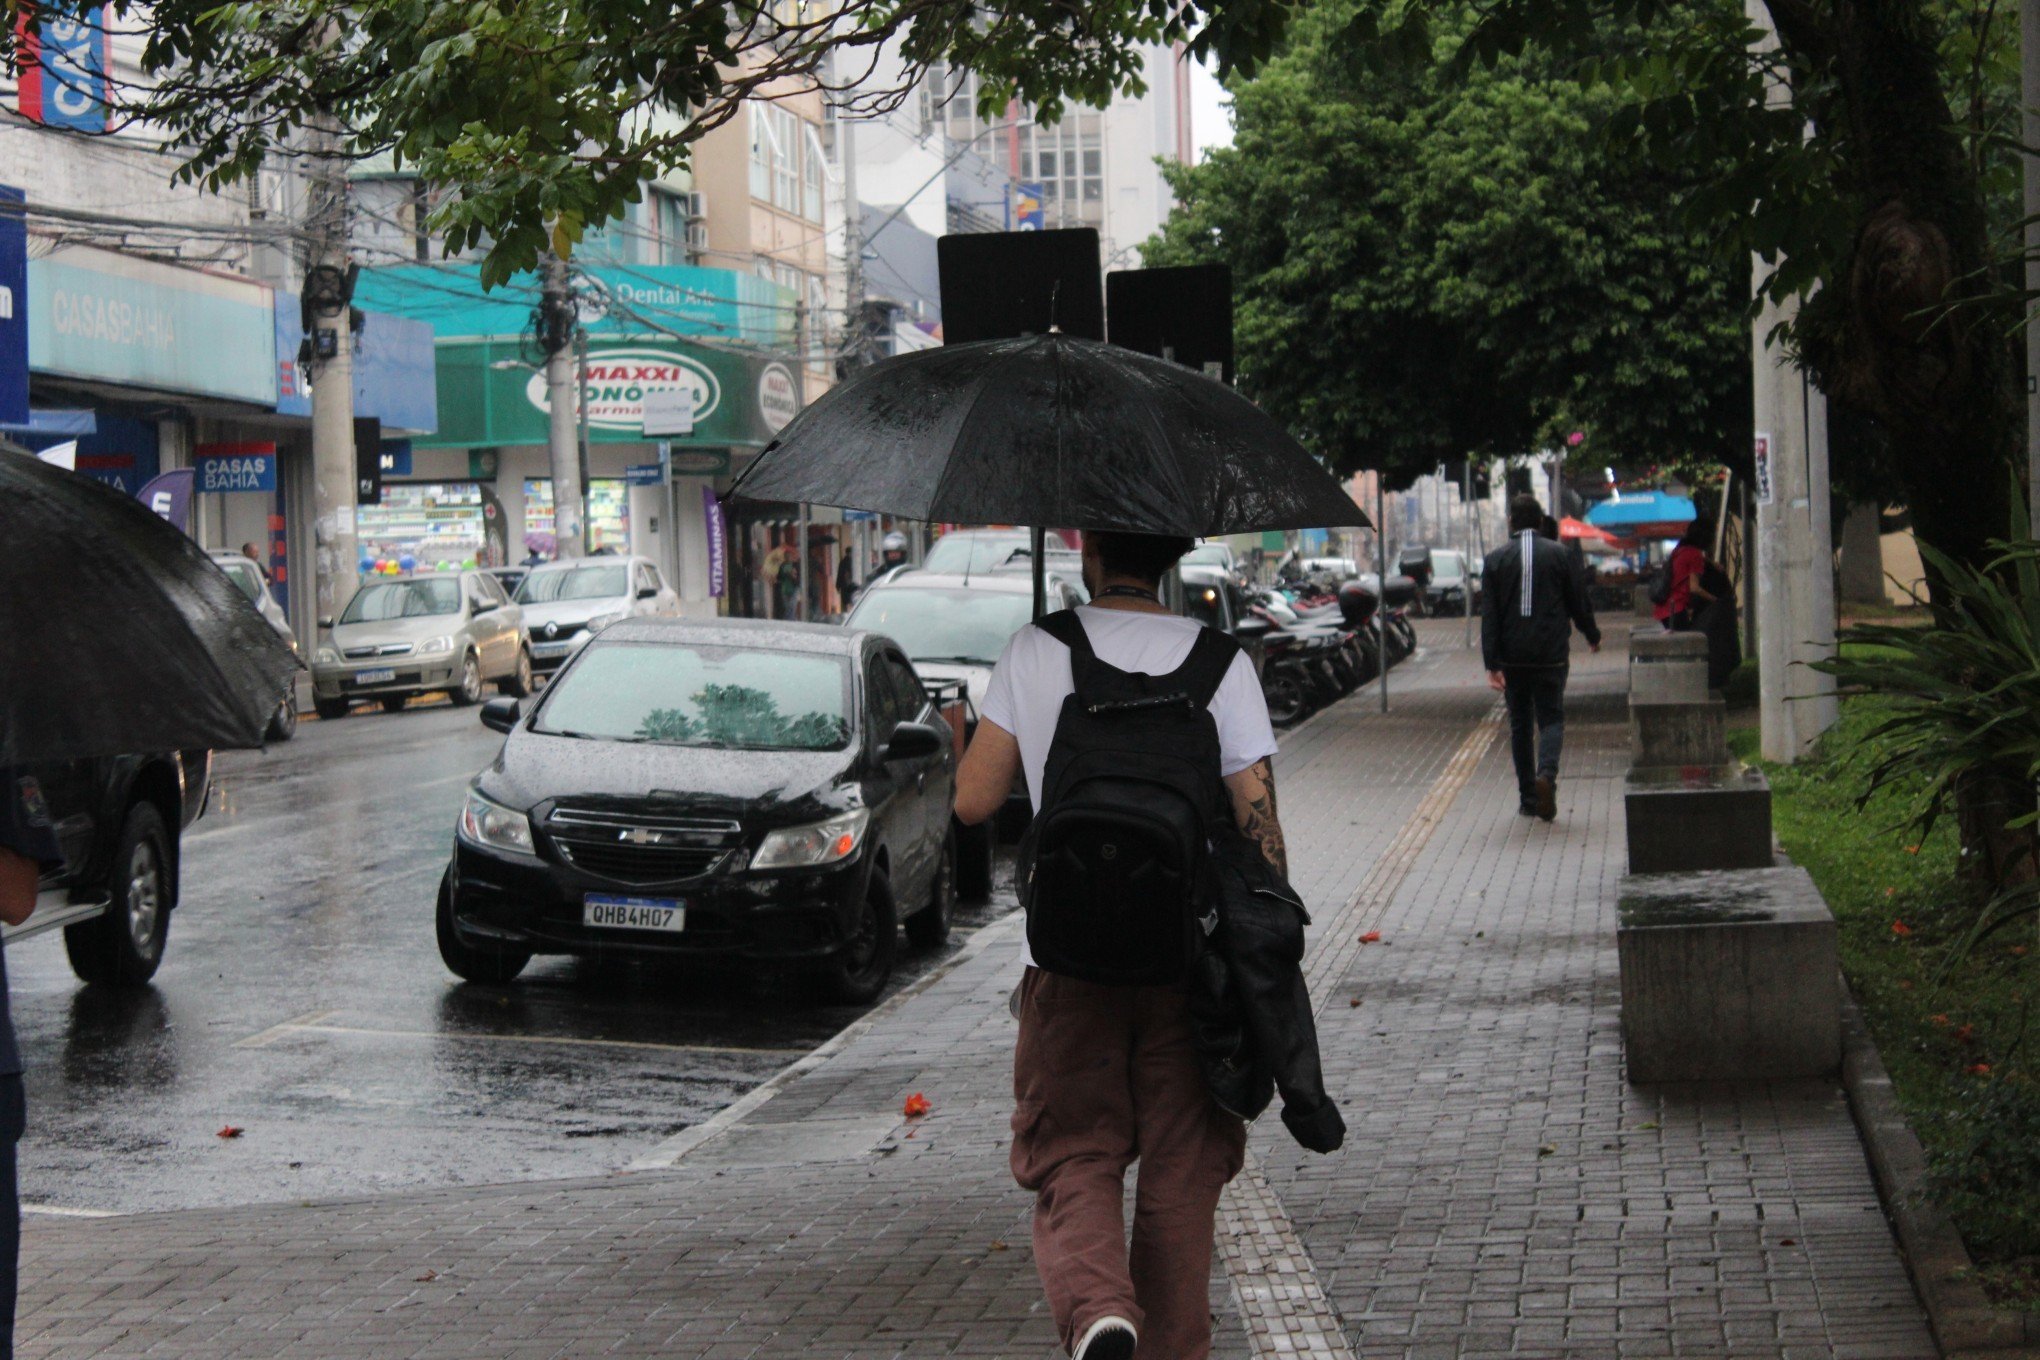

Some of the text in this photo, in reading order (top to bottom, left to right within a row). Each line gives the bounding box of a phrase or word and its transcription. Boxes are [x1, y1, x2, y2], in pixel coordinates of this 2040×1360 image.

[616, 283, 680, 304] Dental
[576, 366, 681, 382] MAXXI
[205, 459, 266, 474] CASAS
[205, 474, 259, 489] BAHIA
[710, 505, 722, 594] VITAMINAS
[593, 905, 674, 927] QHB4H07
